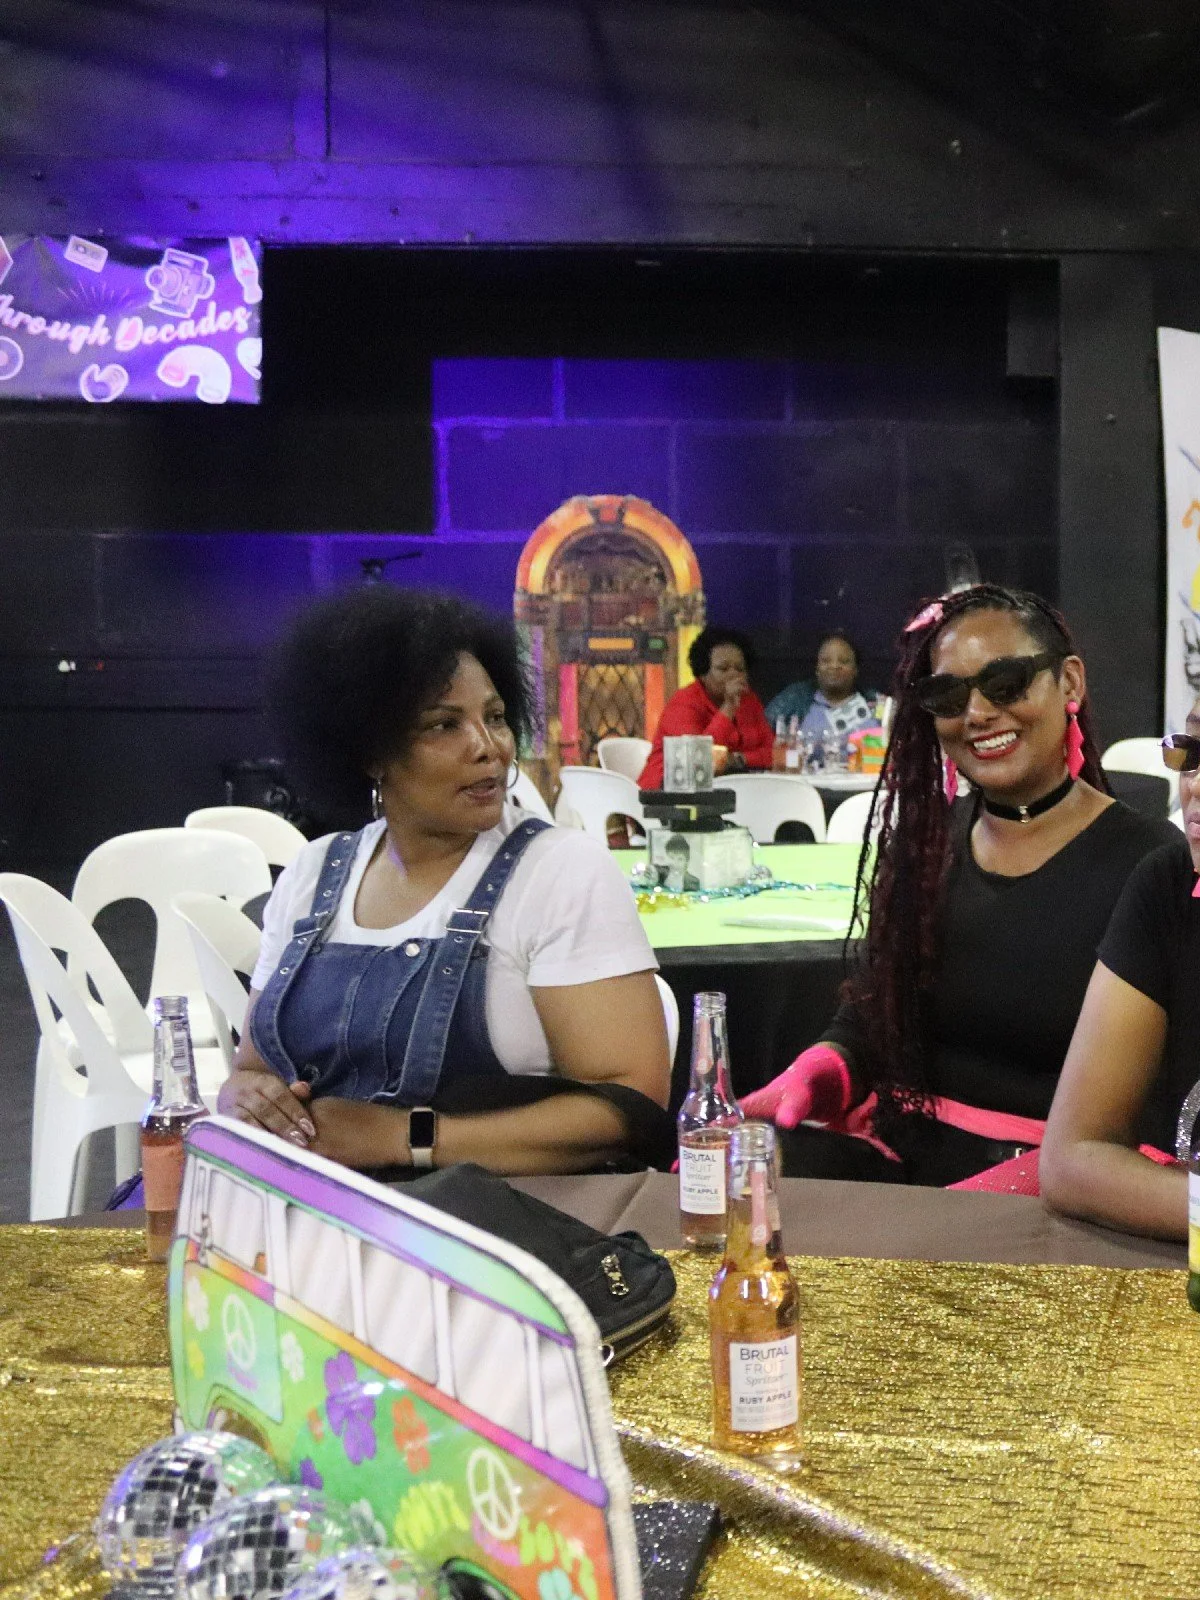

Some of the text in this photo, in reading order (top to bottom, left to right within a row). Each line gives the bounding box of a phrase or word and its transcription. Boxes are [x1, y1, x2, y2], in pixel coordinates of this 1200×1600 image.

[114, 301, 251, 352] Decades
[740, 1346, 789, 1362] BRUTAL
[745, 1360, 784, 1374] FRUIT
[766, 1390, 791, 1402] APPLE
